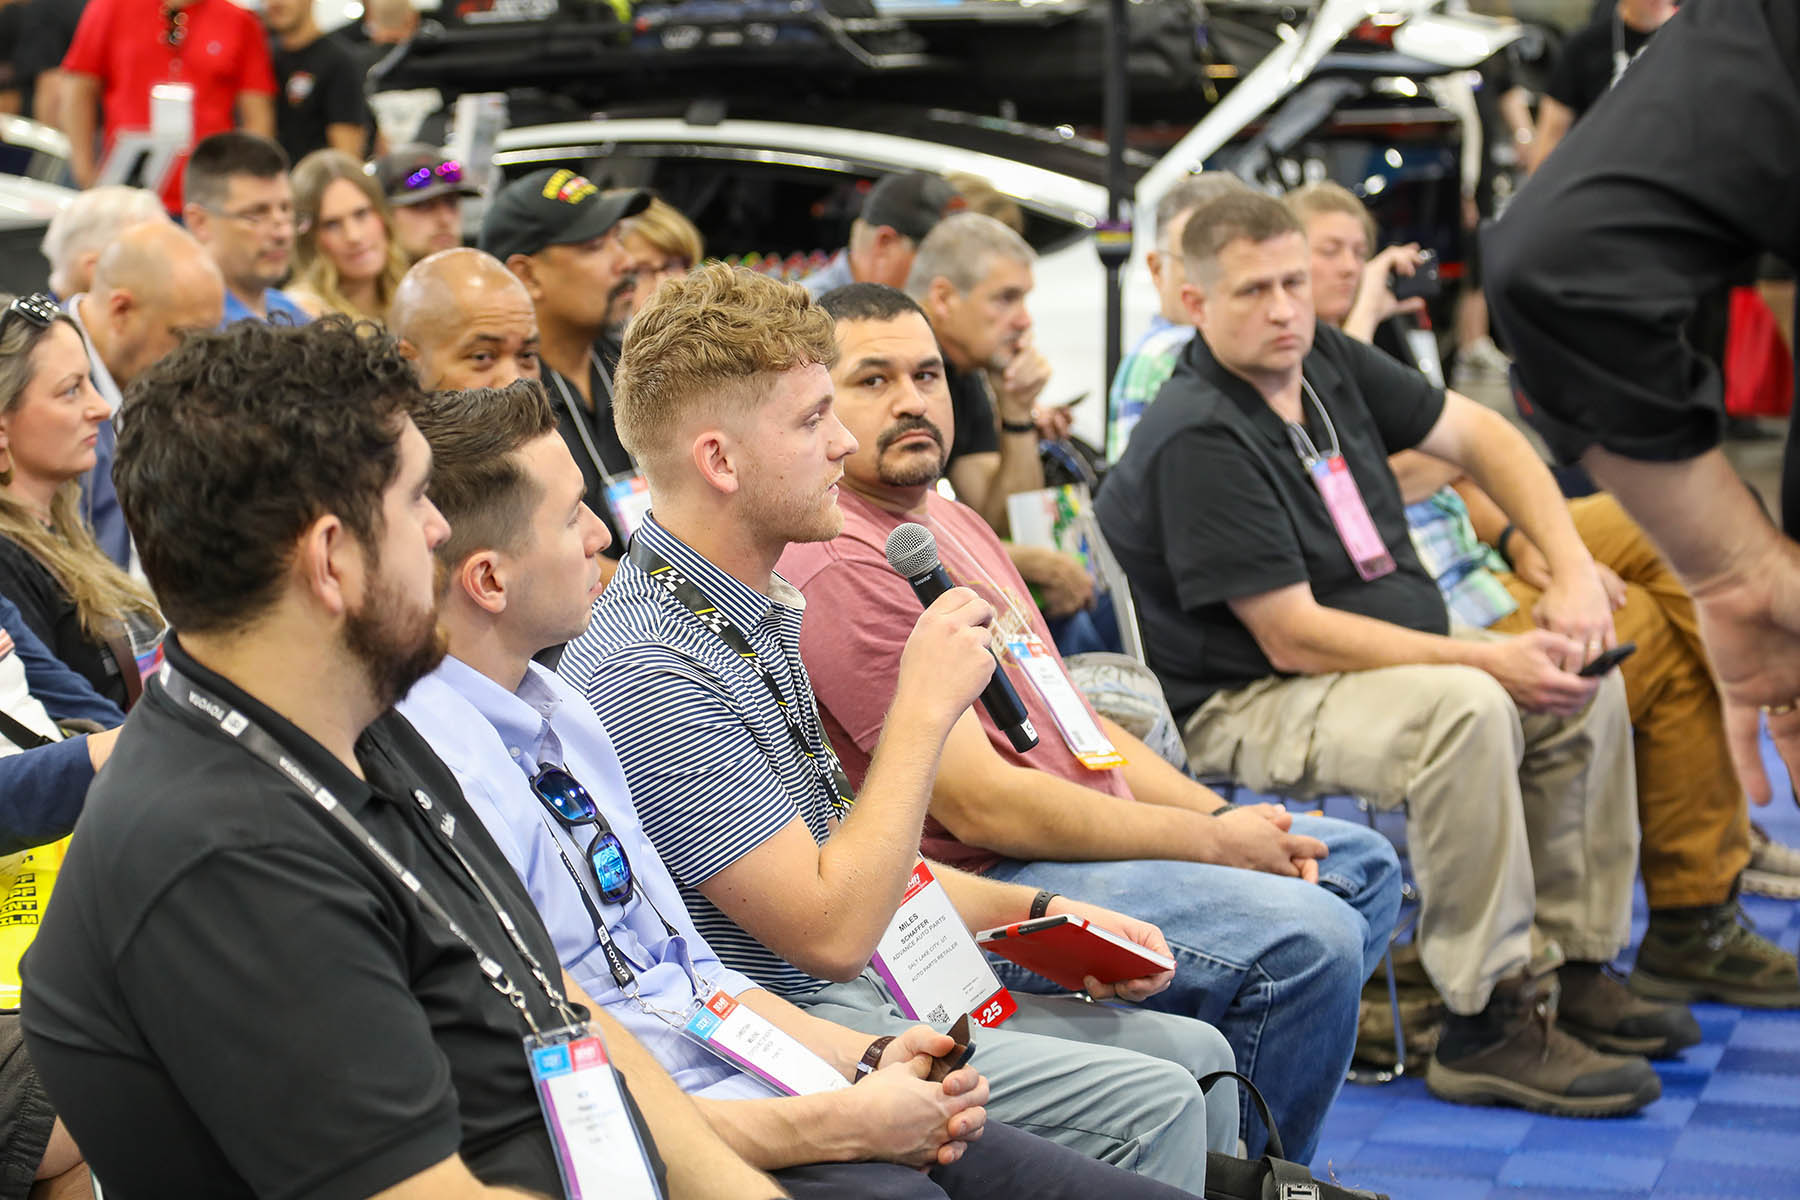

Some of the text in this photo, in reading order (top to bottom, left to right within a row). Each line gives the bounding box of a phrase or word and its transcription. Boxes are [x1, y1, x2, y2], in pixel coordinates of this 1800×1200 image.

[899, 913, 919, 932] MILES
[901, 919, 929, 944] SCHAFFER
[893, 915, 946, 960] ADVANCE AUTO PARTS
[606, 945, 630, 982] TOYOTA
[912, 970, 924, 982] AUTO
